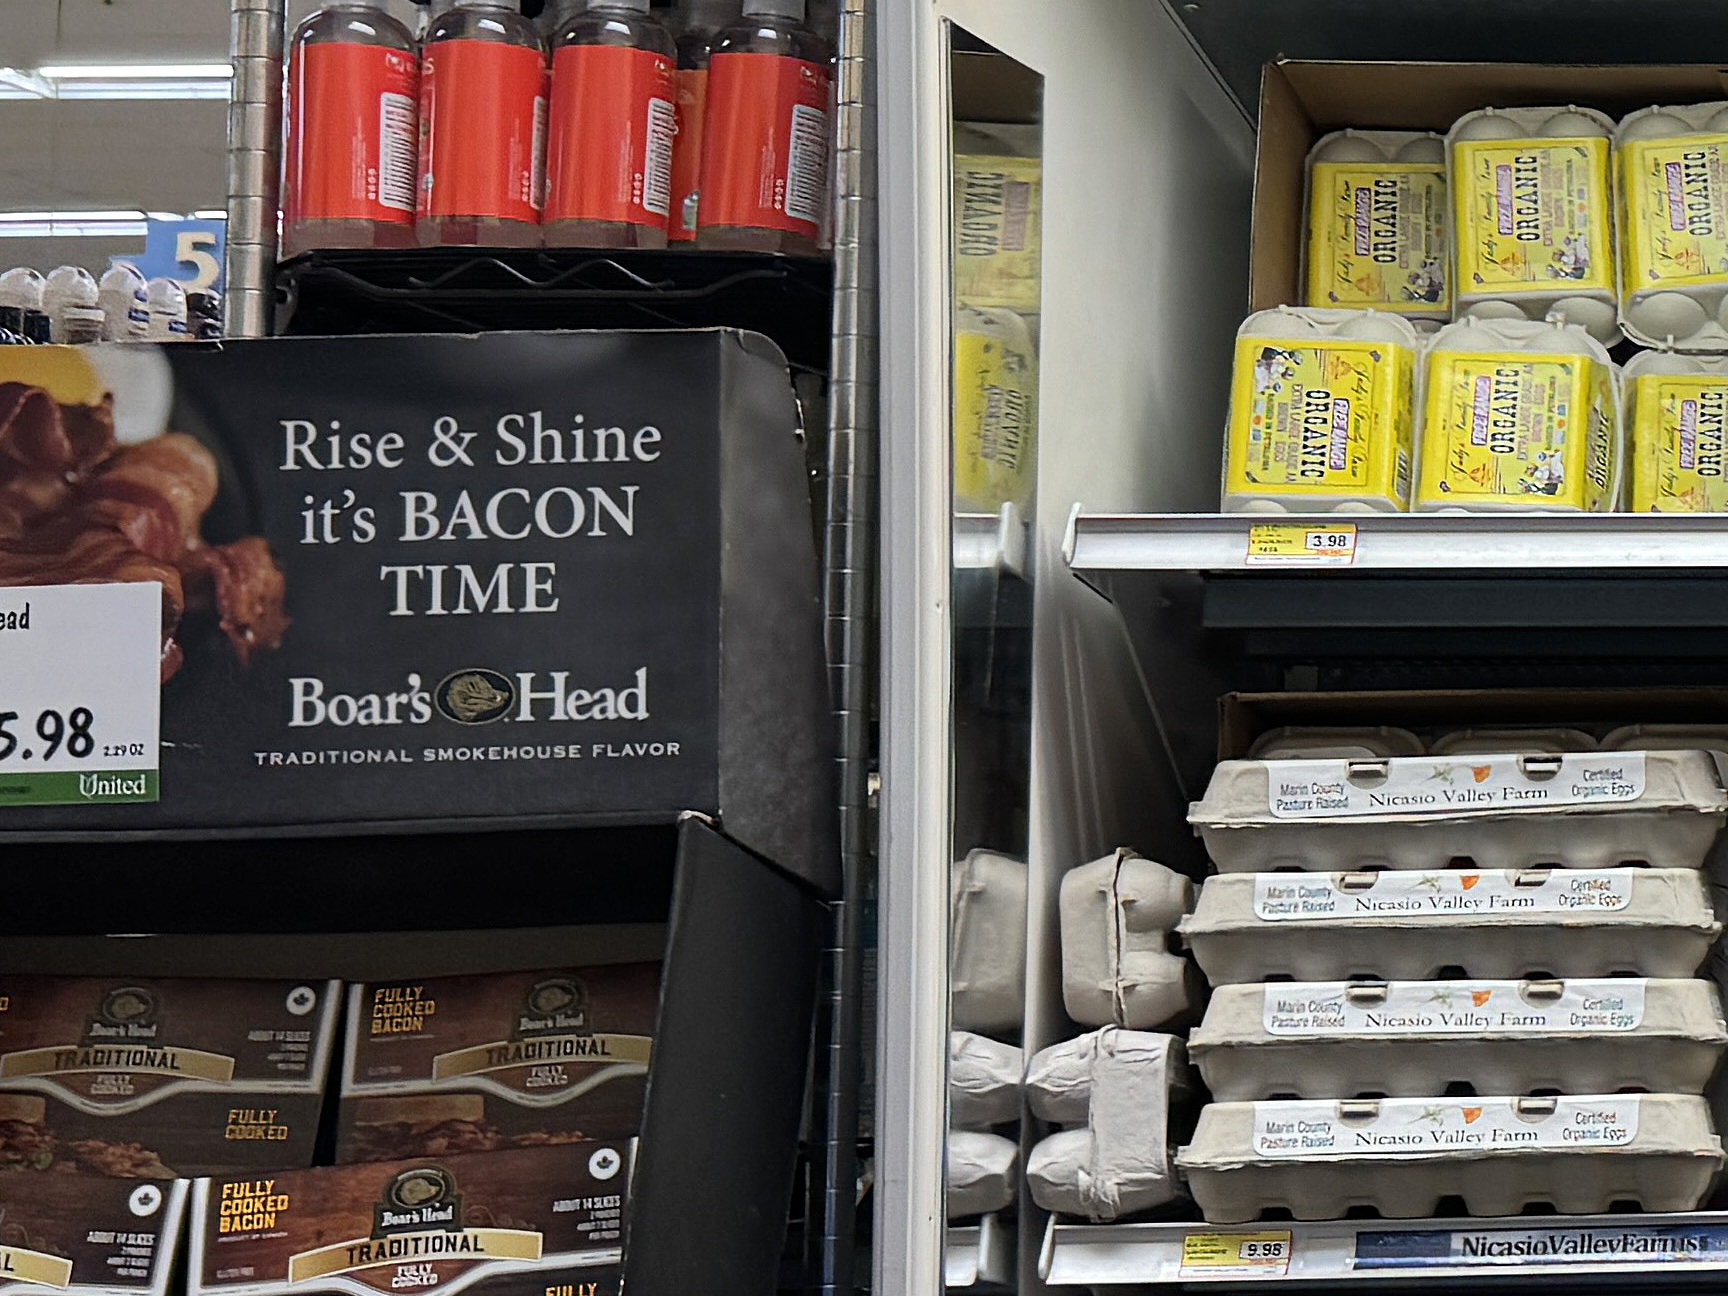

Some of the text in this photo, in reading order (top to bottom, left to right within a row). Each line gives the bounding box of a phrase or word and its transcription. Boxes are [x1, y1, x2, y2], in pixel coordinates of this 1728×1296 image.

[1515, 156, 1540, 241] ORGANIC
[1683, 152, 1712, 236] ORGANIC
[1373, 179, 1398, 263] ORGANIC
[1490, 369, 1519, 454] ORGANIC
[279, 411, 661, 471] Rise & Shine
[1300, 390, 1330, 479] ORGANIC
[1697, 392, 1723, 476] ORGANIC
[300, 486, 640, 544] it's BACON
[1312, 534, 1347, 548] 3.98
[379, 563, 559, 615] TIME
[0, 603, 30, 629] ead
[288, 667, 649, 727] Boar's Head
[103, 743, 144, 756] 2.29 OZ
[254, 742, 681, 766] TRADITIONAL SMOKEHOUSE FLAVOR
[80, 774, 146, 799] United
[1369, 787, 1548, 807] Nicasio Valley Farm
[375, 986, 424, 1003] FULLY
[373, 1001, 436, 1018] COOKED
[1365, 1013, 1546, 1027] Nicasio Valley Farm
[371, 1016, 424, 1034] BACON
[55, 1049, 180, 1070] TRADITIONAL
[486, 1038, 611, 1065] TRADITIONAL
[228, 1109, 278, 1124] FULLY
[225, 1125, 288, 1140] COOKED
[222, 1180, 274, 1198] FULLY
[220, 1195, 289, 1216] COOKED
[219, 1212, 276, 1233] BACON
[346, 1233, 484, 1265] TRADITIONAL
[1246, 1240, 1283, 1257] 9.98
